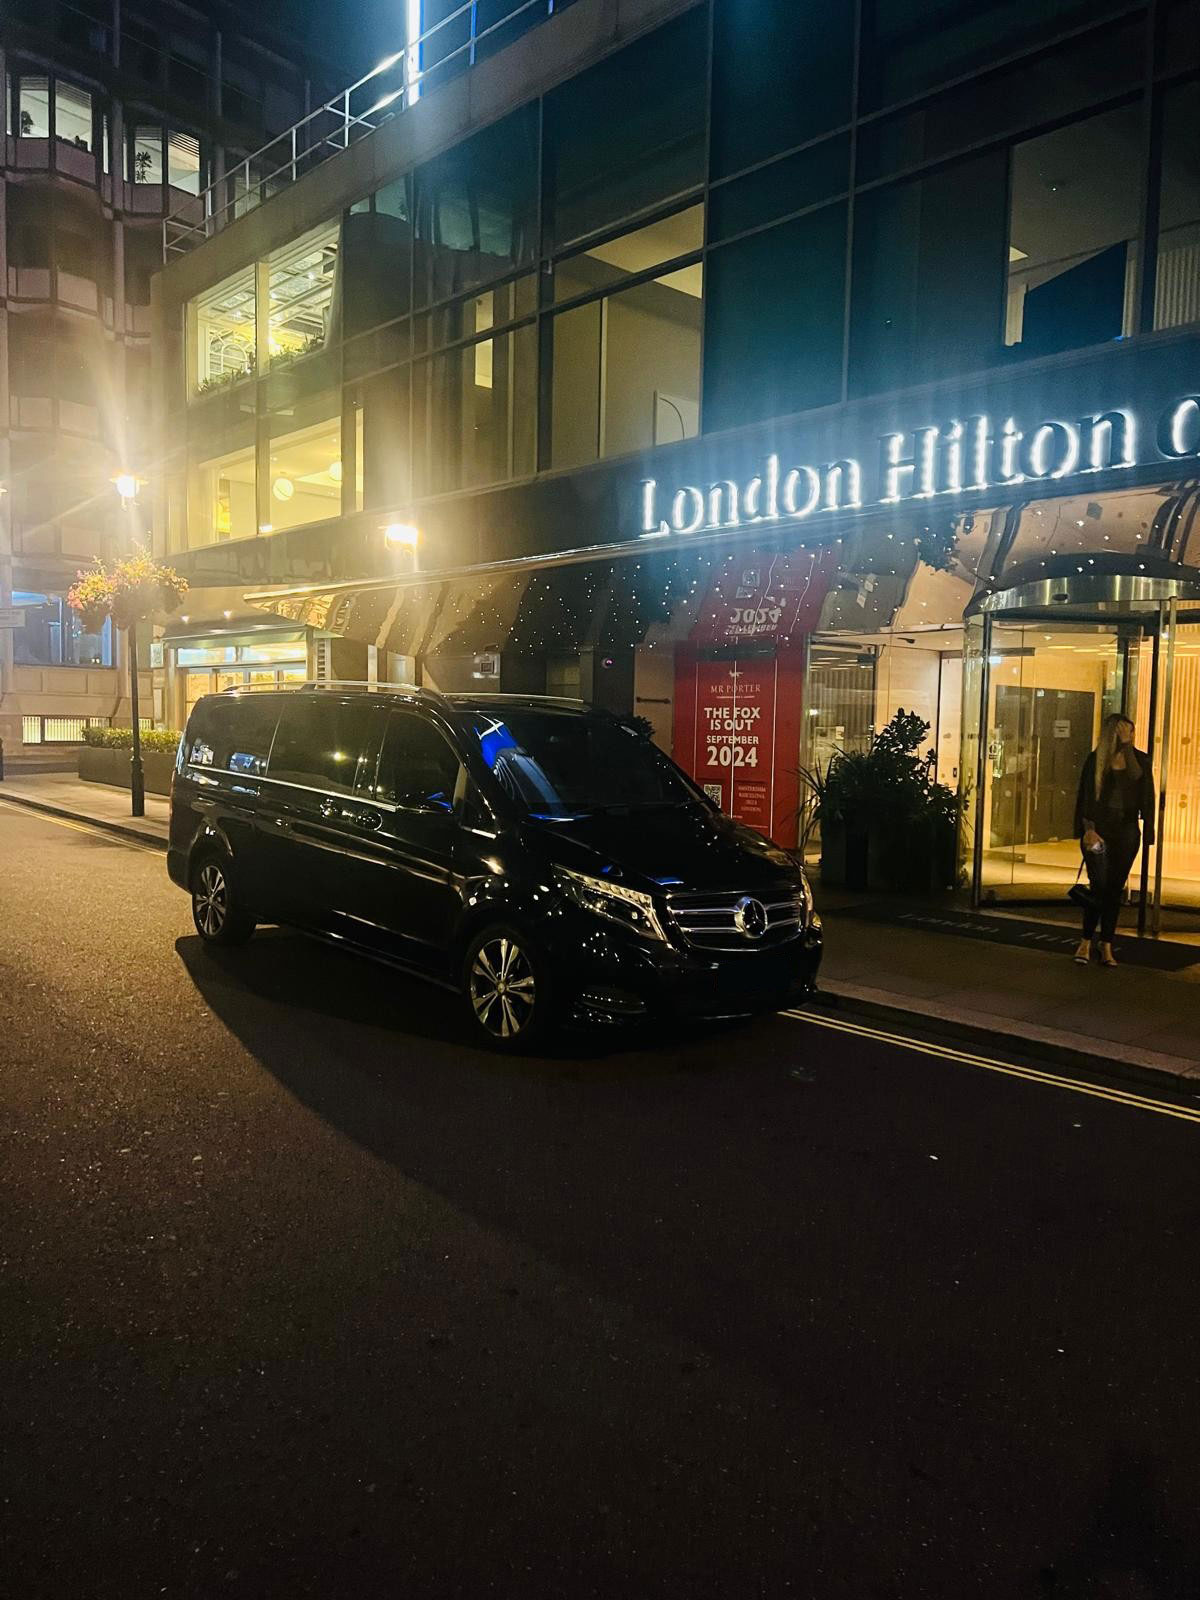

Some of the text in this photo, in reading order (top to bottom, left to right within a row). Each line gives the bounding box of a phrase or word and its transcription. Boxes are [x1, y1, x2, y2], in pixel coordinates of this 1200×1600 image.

[638, 453, 862, 539] London
[877, 408, 1137, 504] Hilton
[711, 684, 761, 693] MR PORTER
[703, 707, 761, 719] THE FOX
[710, 719, 754, 731] IS OUT
[706, 735, 759, 745] SEPTEMBER
[706, 745, 759, 768] 2024
